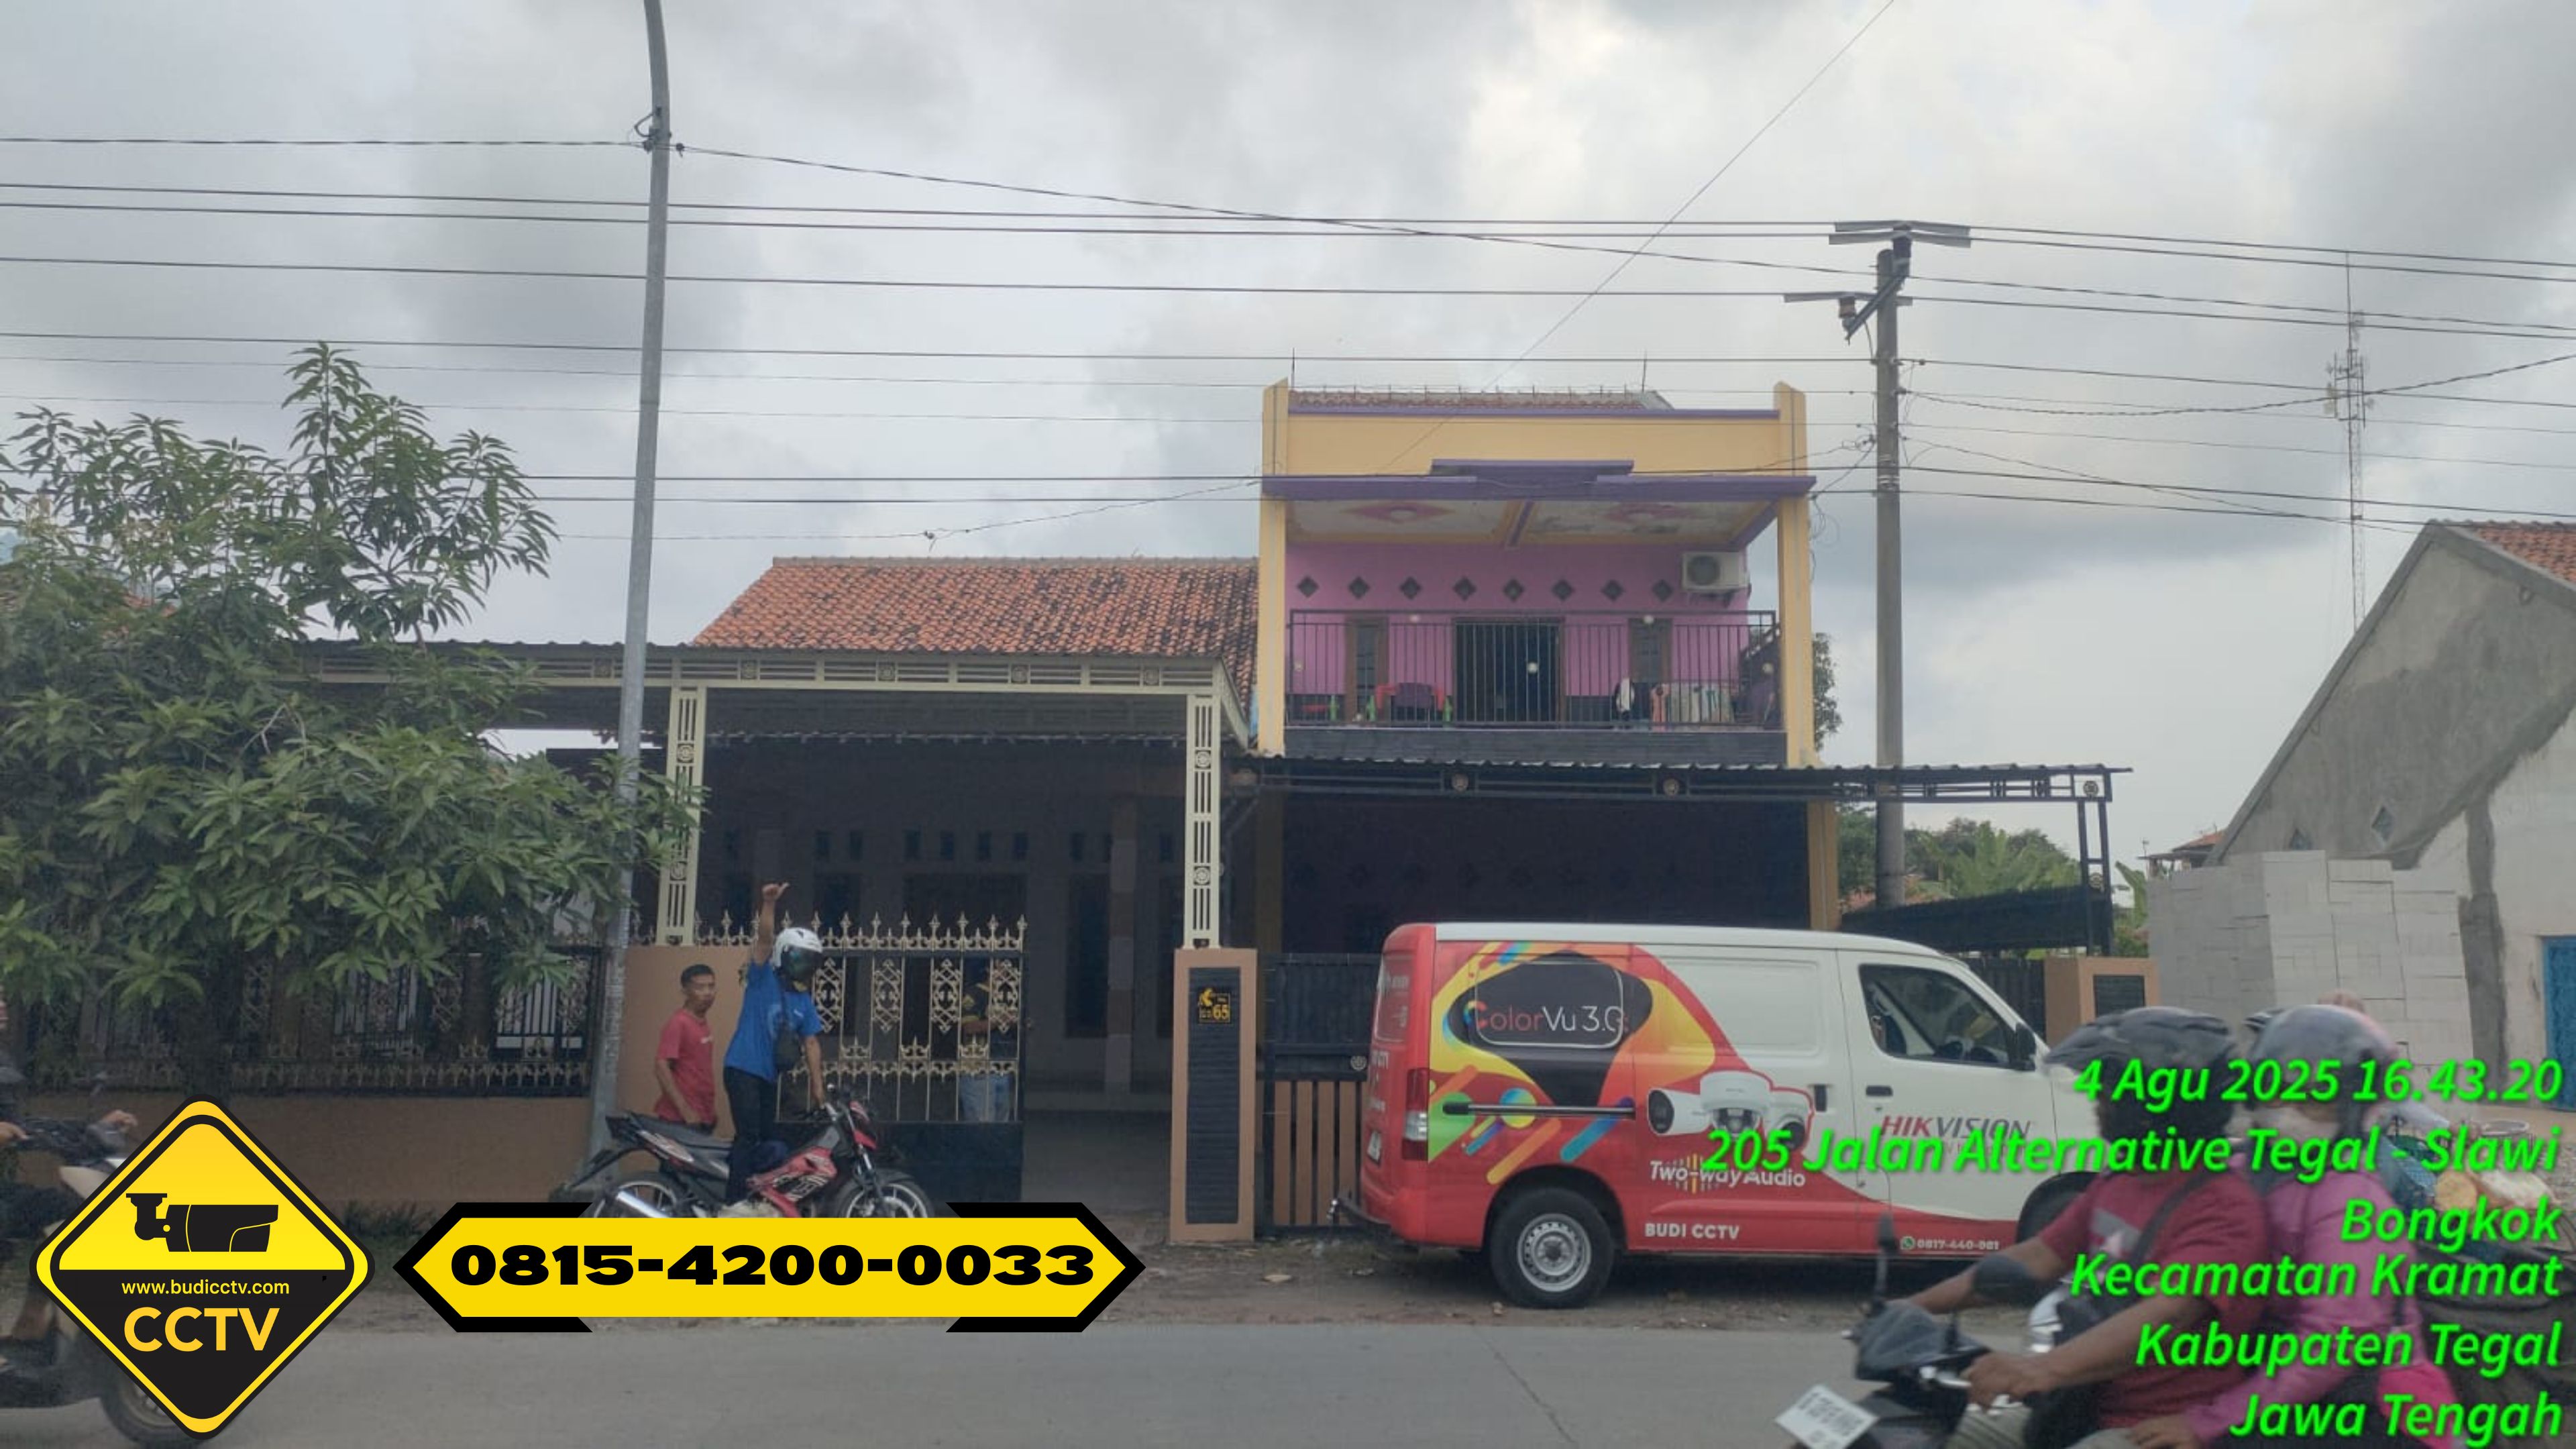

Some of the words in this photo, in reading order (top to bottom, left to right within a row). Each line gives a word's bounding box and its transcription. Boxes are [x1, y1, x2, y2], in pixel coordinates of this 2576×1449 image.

[1213, 1004, 1229, 1020] 65
[1463, 1000, 1576, 1032] ColorVu
[1880, 1116, 2031, 1139] HIKVISION
[1743, 1167, 1805, 1186] Audio
[1645, 1223, 1686, 1237] BUDI
[1692, 1224, 1739, 1240] CCTV
